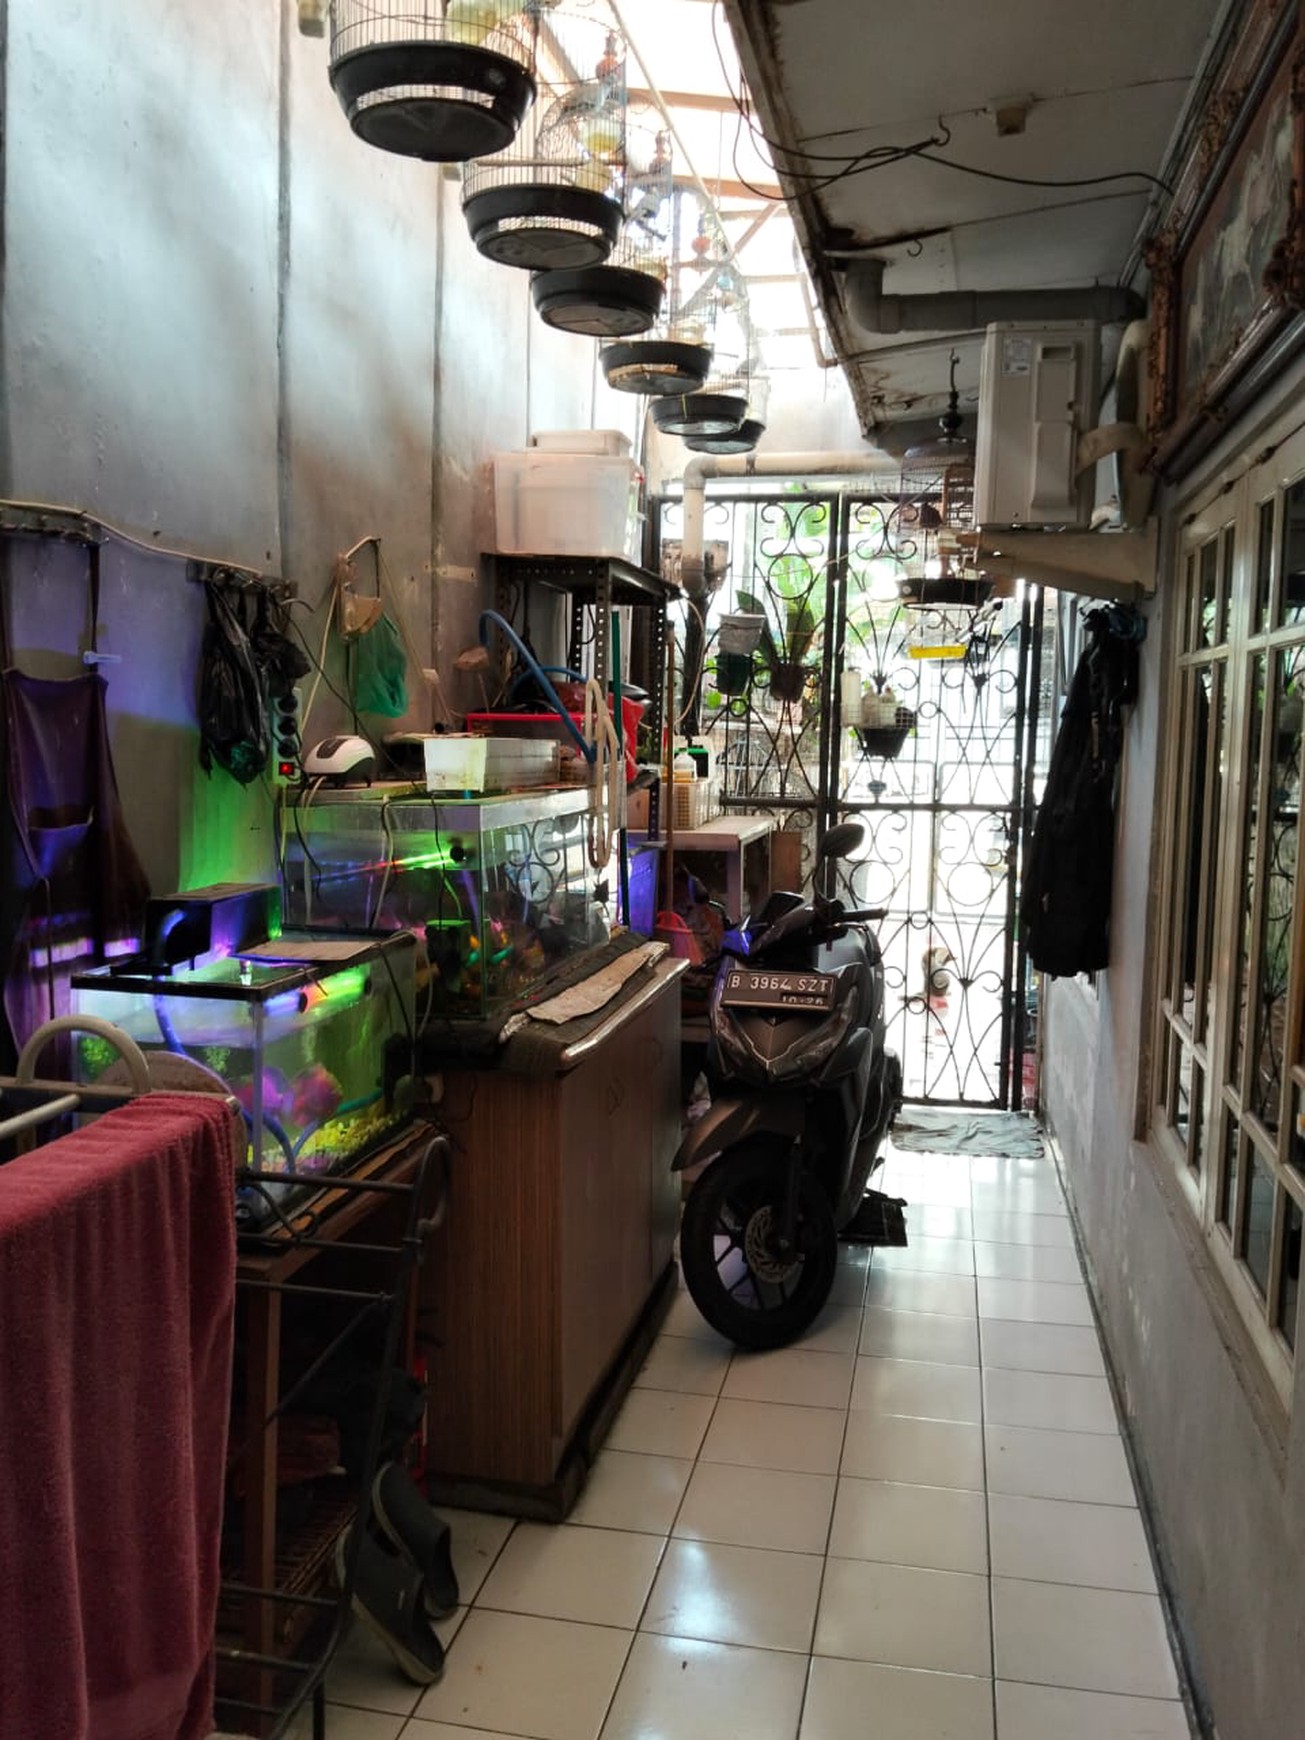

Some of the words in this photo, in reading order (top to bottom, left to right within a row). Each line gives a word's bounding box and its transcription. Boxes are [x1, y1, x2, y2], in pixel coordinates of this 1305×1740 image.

[731, 975, 740, 988] B
[750, 976, 792, 990] 3964
[797, 978, 829, 992] SZT
